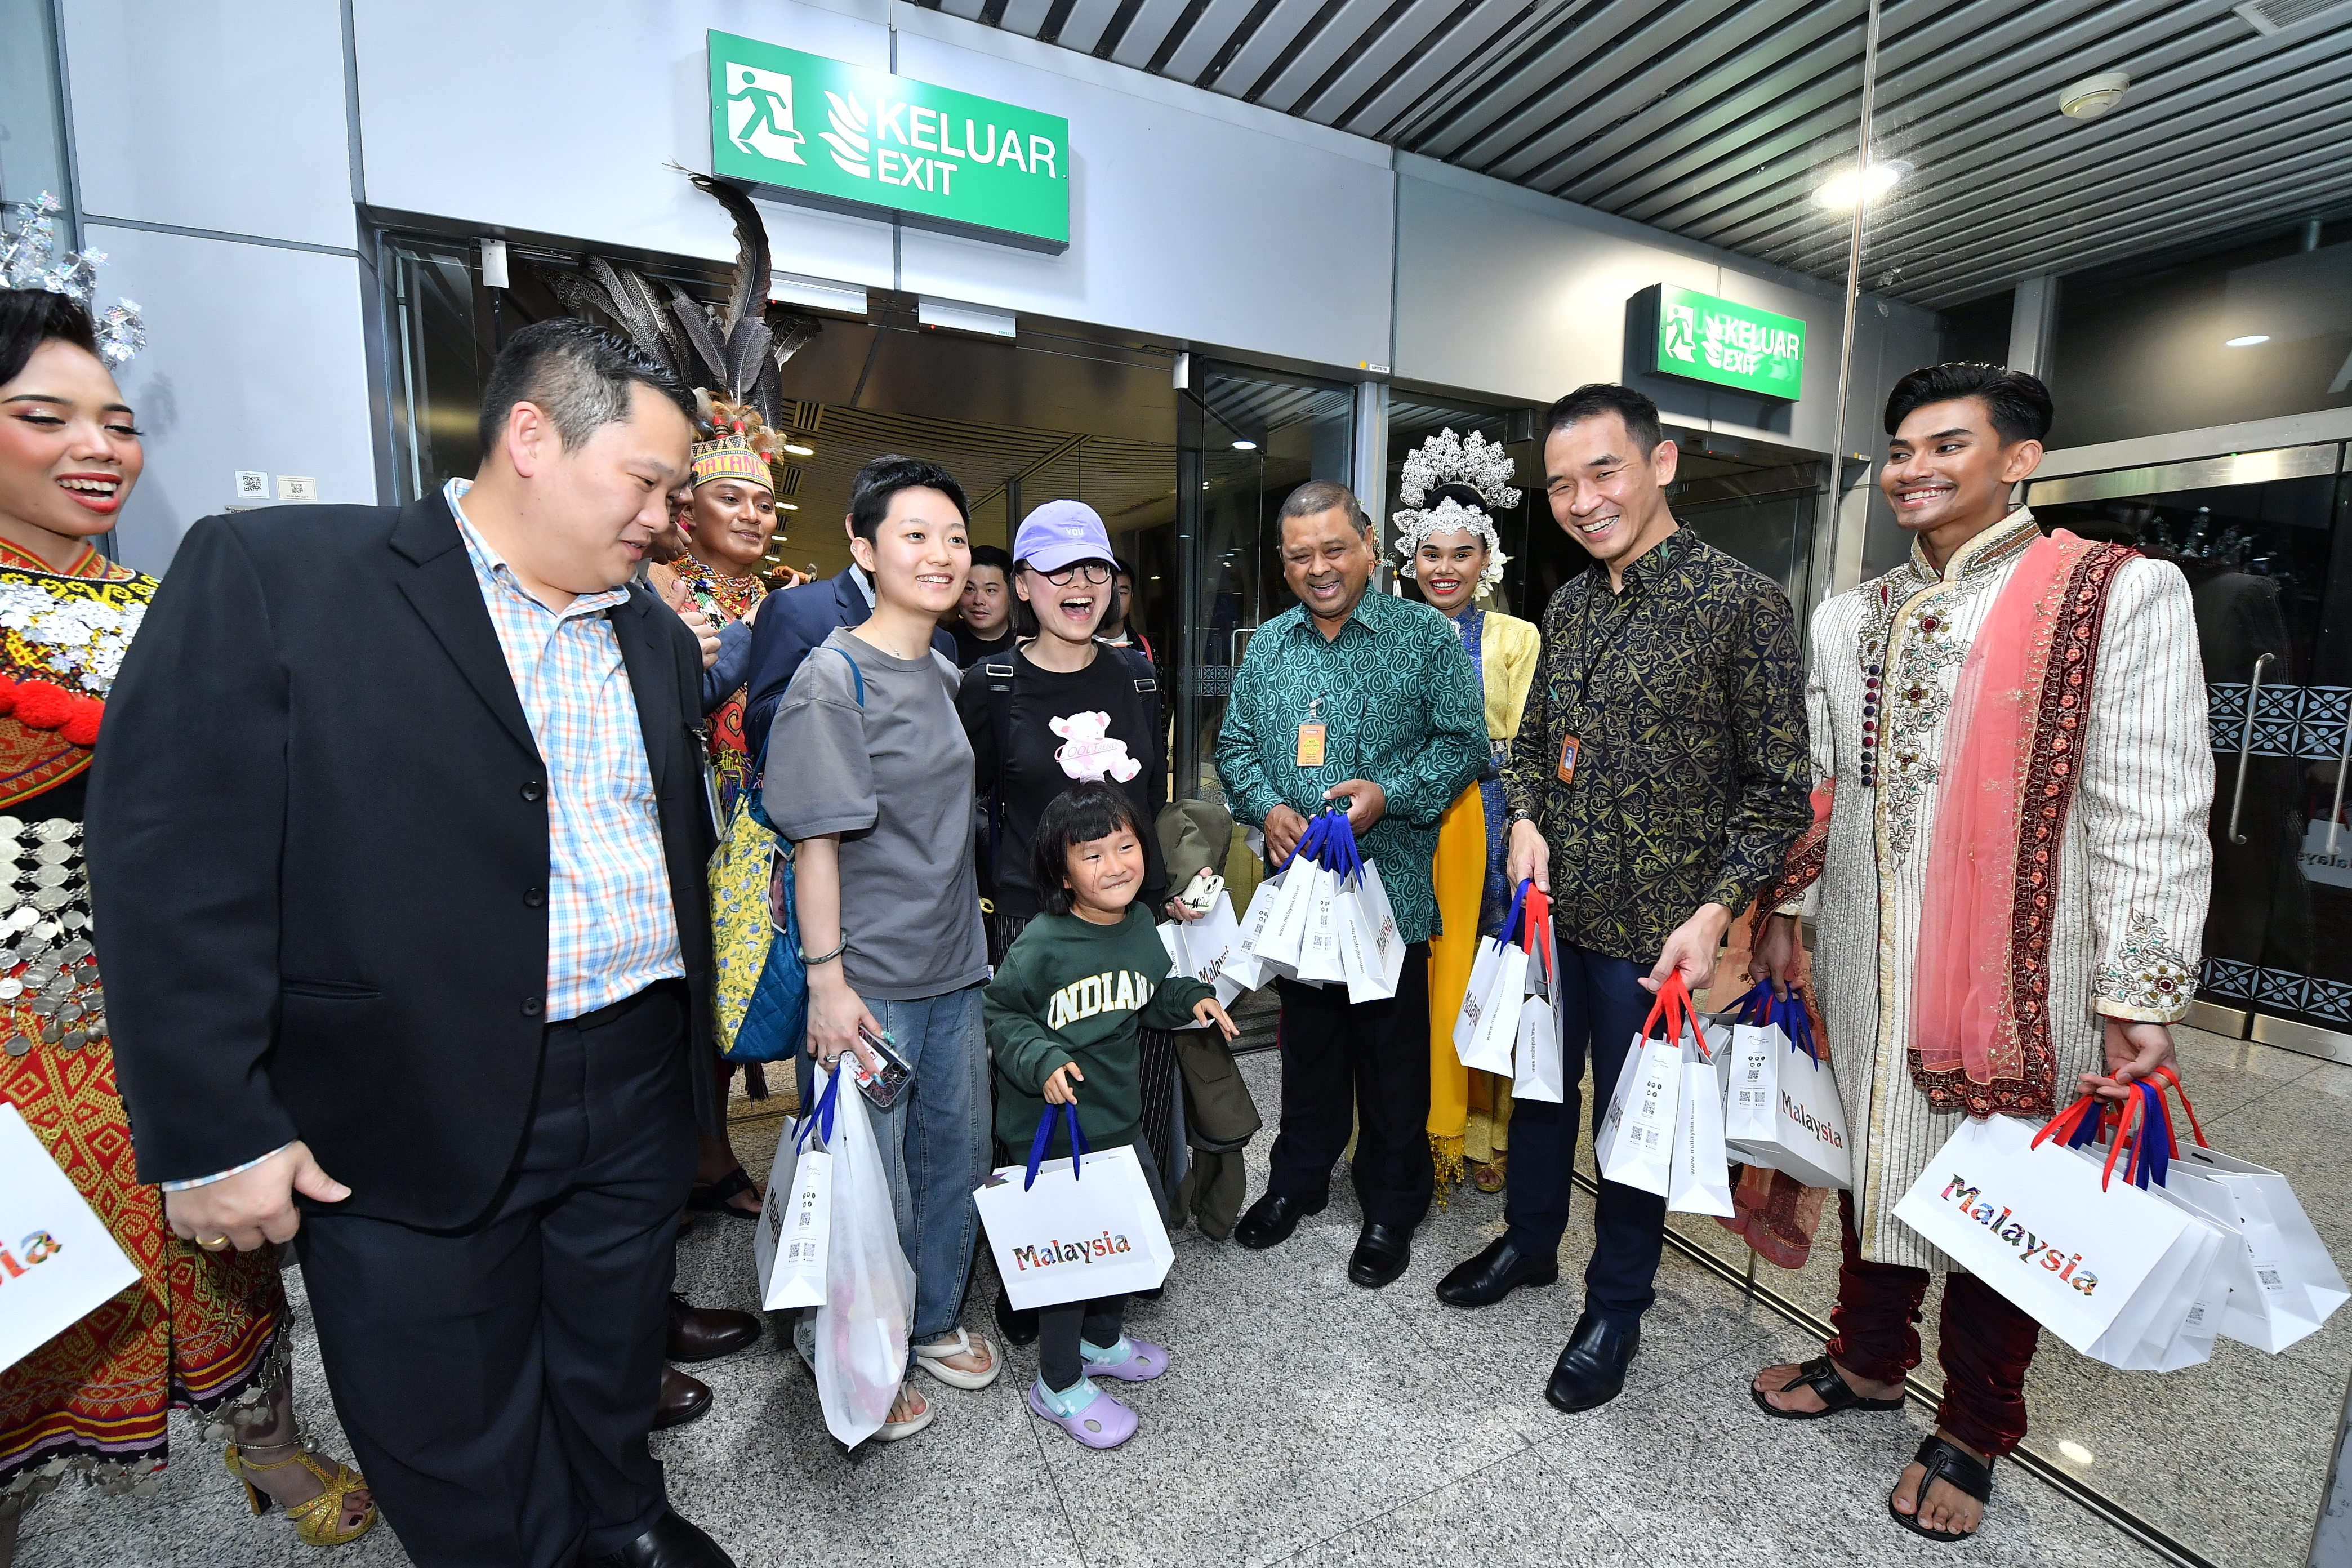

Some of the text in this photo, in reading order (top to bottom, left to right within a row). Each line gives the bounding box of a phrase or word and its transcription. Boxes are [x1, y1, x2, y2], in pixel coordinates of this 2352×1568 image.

[876, 97, 1057, 179] KELUAR
[877, 148, 958, 195] EXIT
[1723, 349, 1755, 376] EXIT
[1725, 317, 1799, 361] KELUAR
[1066, 527, 1084, 536] YOU
[1054, 744, 1092, 761] COOL
[1278, 885, 1300, 937] www.malaysia.travel
[1348, 919, 1365, 974] www.malaysia.travel
[1047, 970, 1155, 1030] INDIAN
[1486, 981, 1506, 1041] www.malaysia.travel
[1781, 1089, 1843, 1150] Malaysia
[1012, 1230, 1132, 1271] Malaysia
[1940, 1173, 2099, 1297] Malaysia
